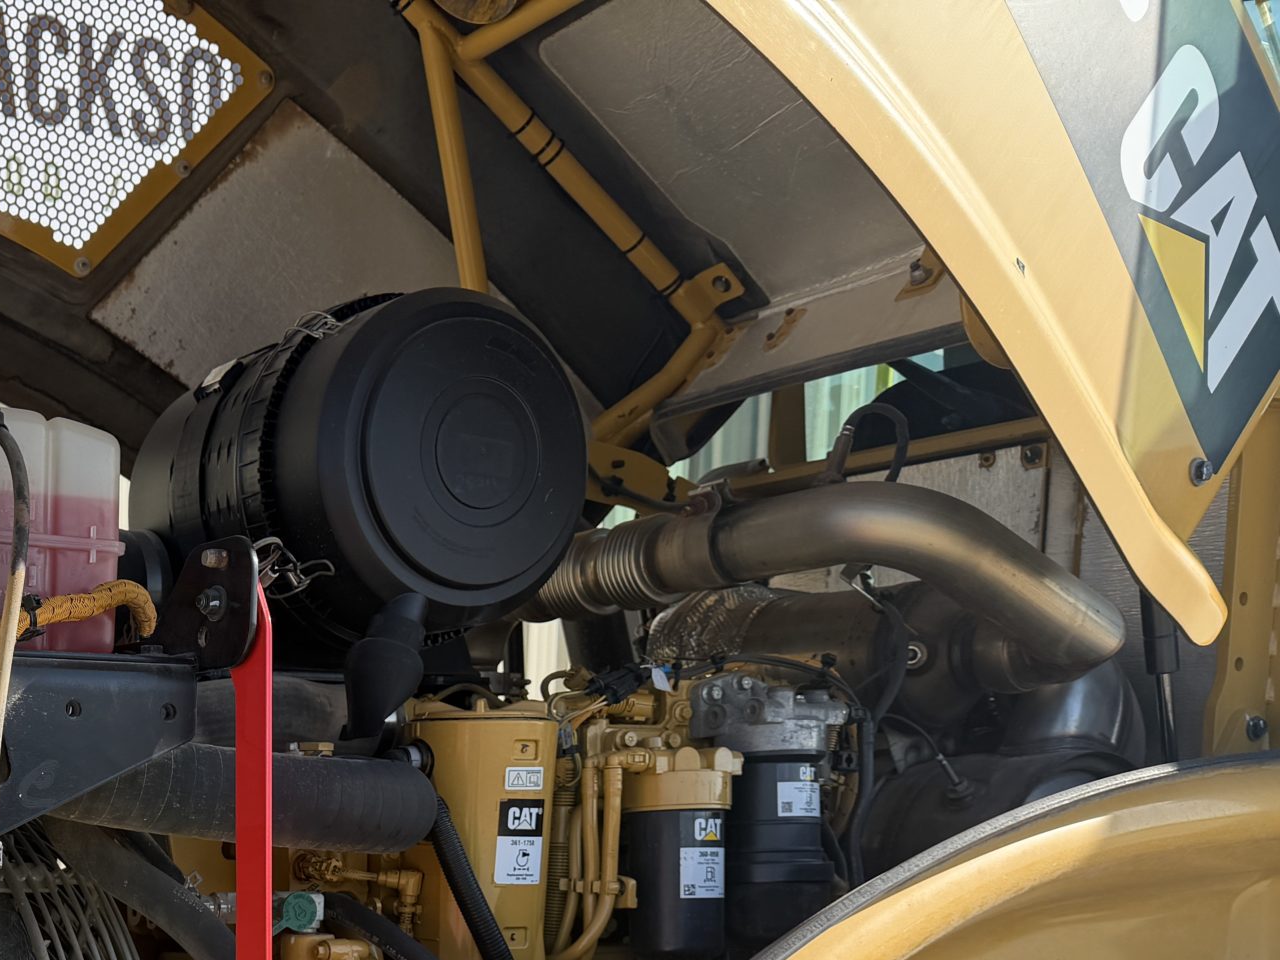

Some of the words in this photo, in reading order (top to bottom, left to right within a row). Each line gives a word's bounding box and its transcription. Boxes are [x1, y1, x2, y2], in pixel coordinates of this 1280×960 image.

[1120, 44, 1280, 394] CAT
[799, 766, 816, 781] CAT
[507, 806, 540, 830] CAT
[694, 818, 722, 841] CAT
